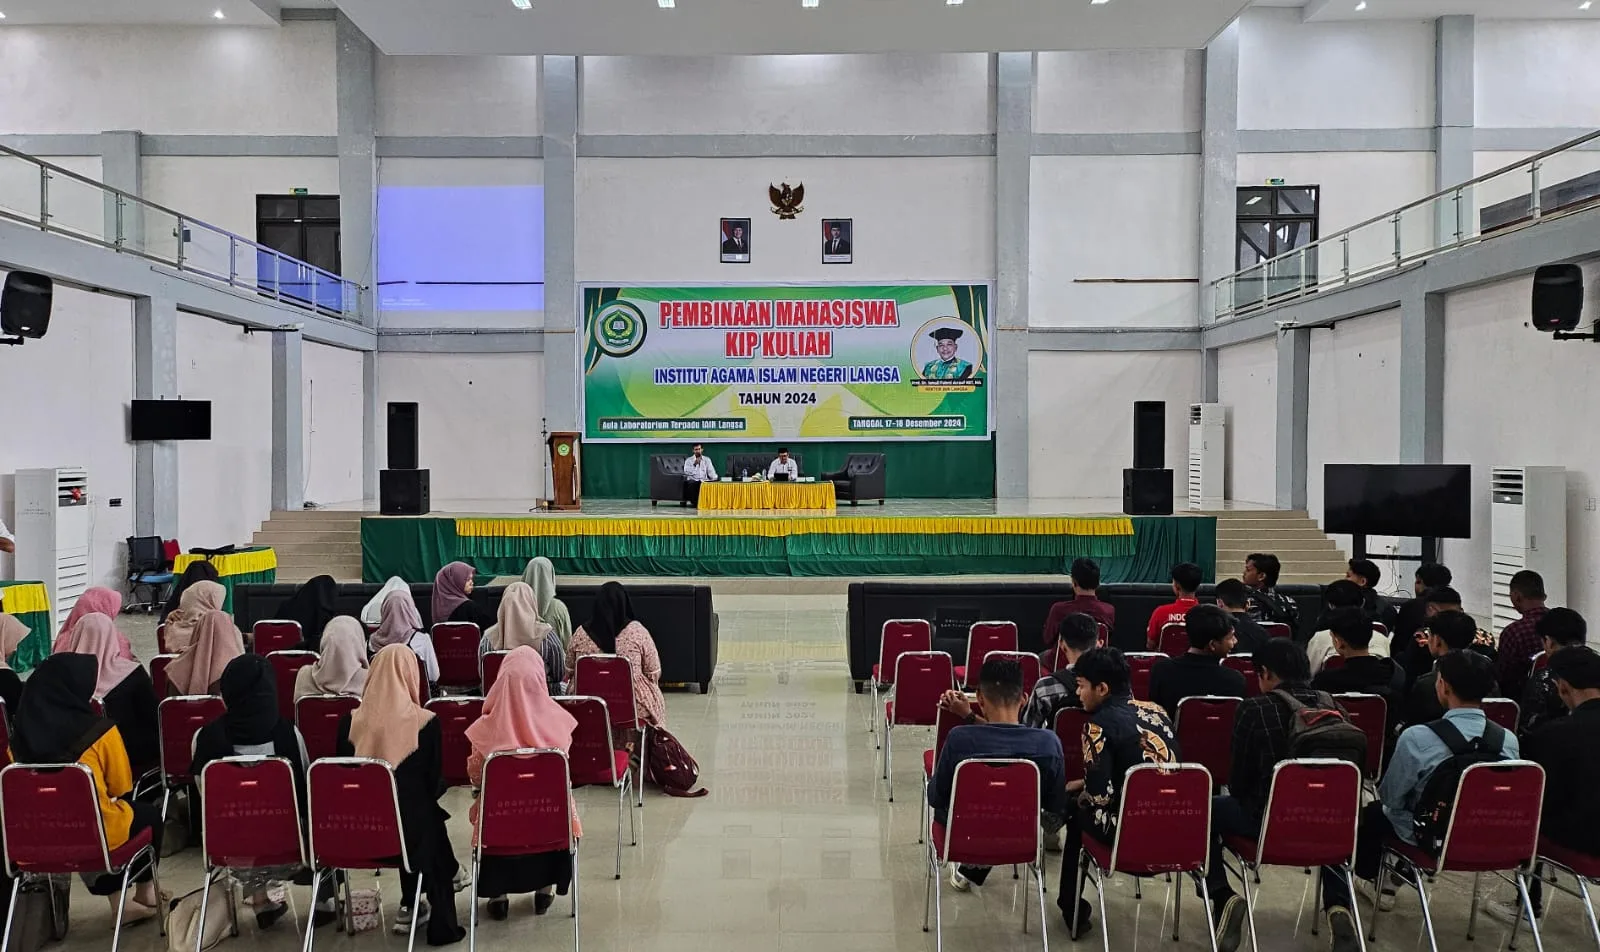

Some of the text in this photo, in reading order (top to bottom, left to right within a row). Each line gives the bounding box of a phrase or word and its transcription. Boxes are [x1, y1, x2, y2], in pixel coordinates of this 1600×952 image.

[659, 300, 898, 327] PEMBINAAN MAHASISWA
[725, 331, 831, 357] KIP KULIAH
[655, 367, 900, 384] INSTITUT AGAMA ISLAM NEGERI LANGSA
[739, 392, 817, 405] TAHUN 2024
[602, 420, 618, 430] Aula
[620, 420, 669, 430] Laboratorium
[671, 420, 700, 430] Terpadu
[718, 420, 744, 430] Langsa
[853, 419, 884, 428] TANGGAL
[905, 419, 941, 428] Desember
[943, 419, 961, 428] 2024
[1168, 613, 1187, 621] INDO
